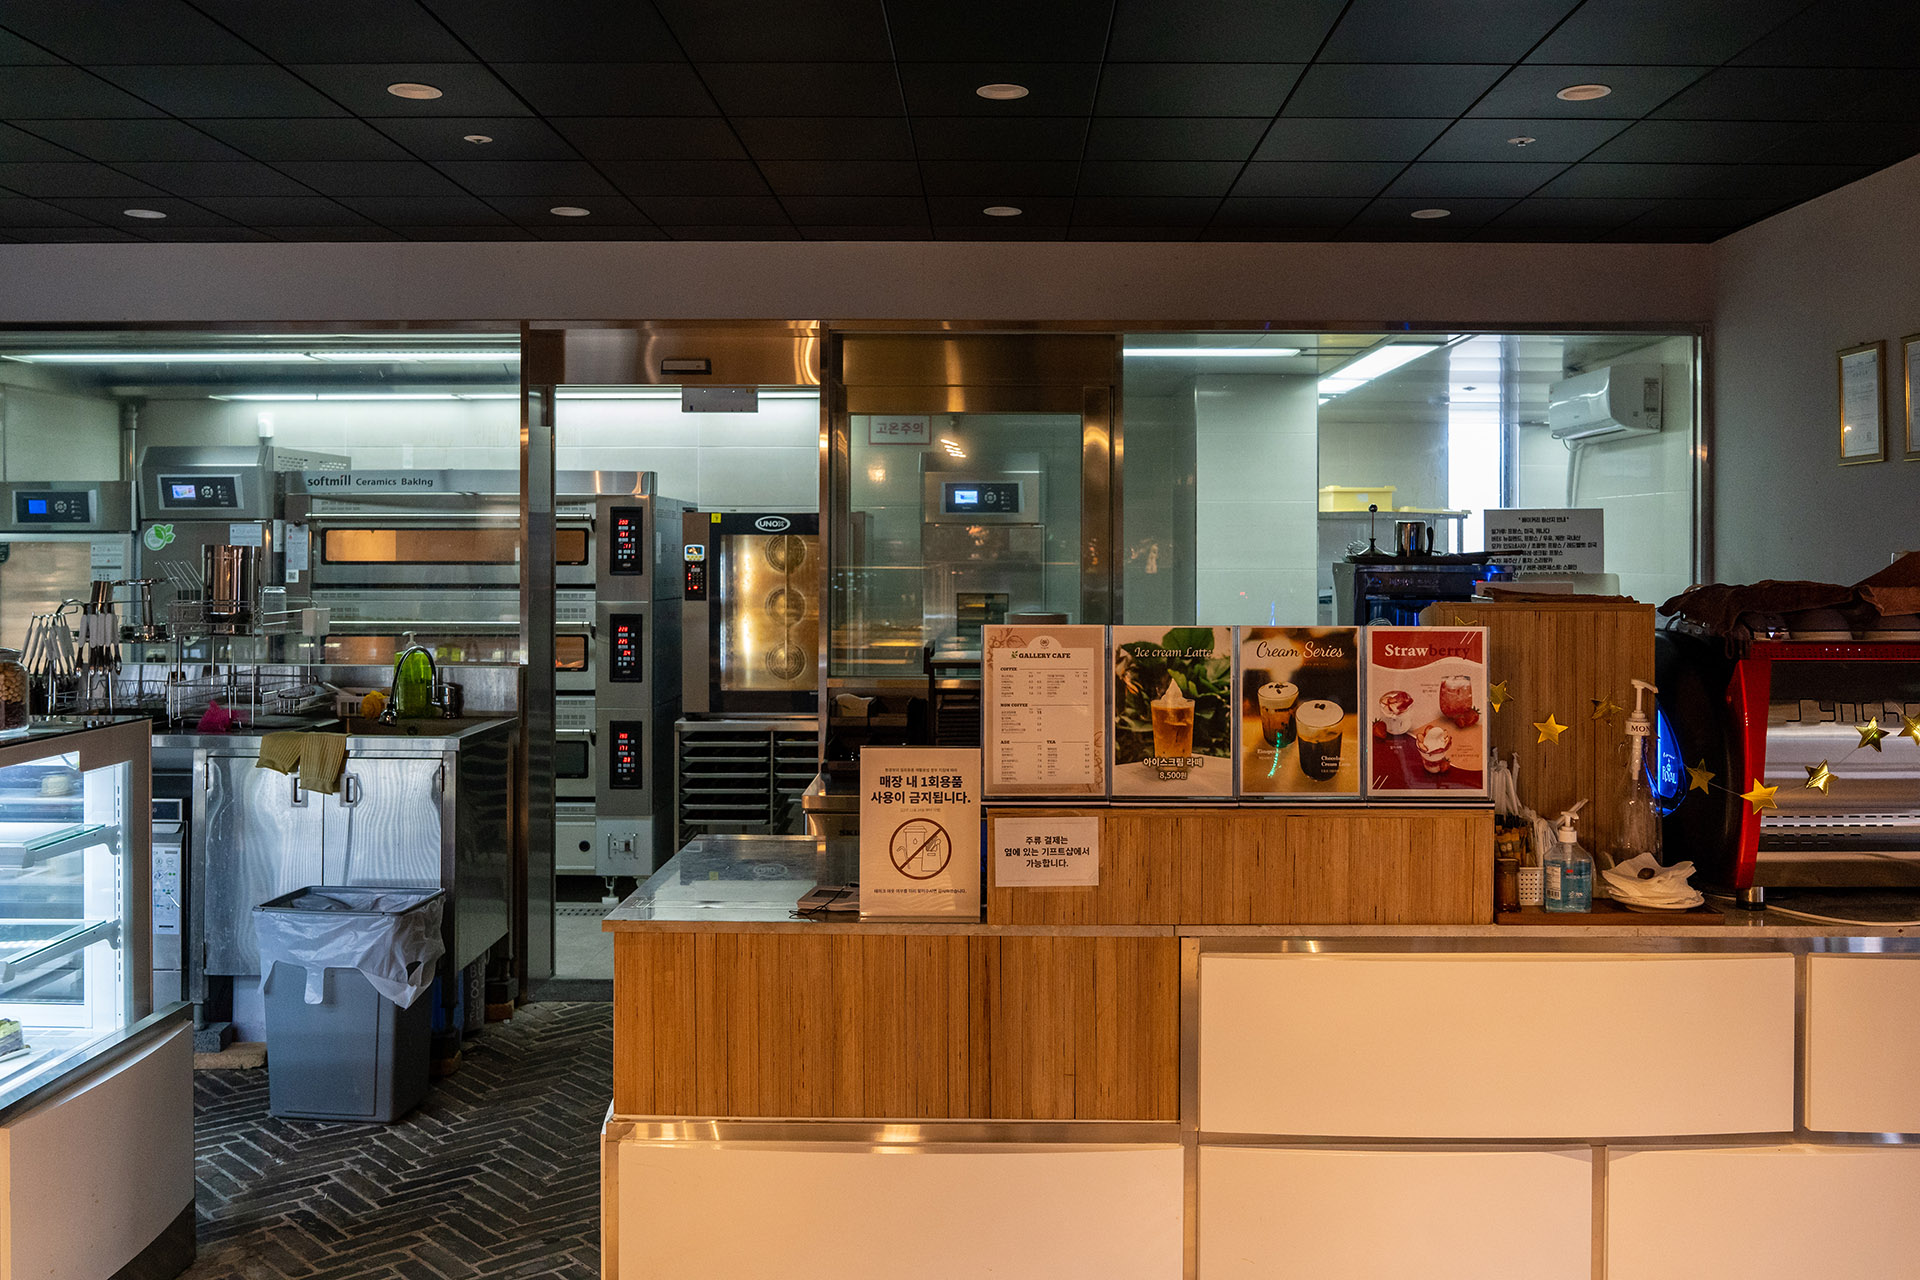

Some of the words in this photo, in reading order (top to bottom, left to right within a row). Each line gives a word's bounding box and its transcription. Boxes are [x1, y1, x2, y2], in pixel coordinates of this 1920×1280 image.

[876, 422, 924, 435] 고온주의
[307, 474, 351, 487] softmill
[356, 477, 397, 486] Ceramics
[401, 477, 433, 487] Baking
[1134, 646, 1149, 658] Ice
[1151, 649, 1182, 658] cream
[1184, 646, 1212, 658] Latte
[1256, 640, 1299, 659] Cream
[1303, 640, 1344, 659] Series
[1384, 643, 1470, 660] Strawberry
[1143, 757, 1184, 767] 아이스크림
[1159, 771, 1187, 780] 8,500원
[879, 775, 904, 789] 매장
[906, 775, 918, 789] 내
[921, 775, 963, 789] 1회용품
[870, 790, 905, 805] 사용이
[908, 790, 971, 805] 금지됩니다.
[1025, 835, 1042, 846] 주류
[1044, 835, 1068, 846] 결제는
[1004, 847, 1020, 857] 옆에
[1022, 847, 1039, 857] 있는
[1041, 847, 1090, 857] 기프트샵에서
[1026, 858, 1069, 869] 가능합니다.
